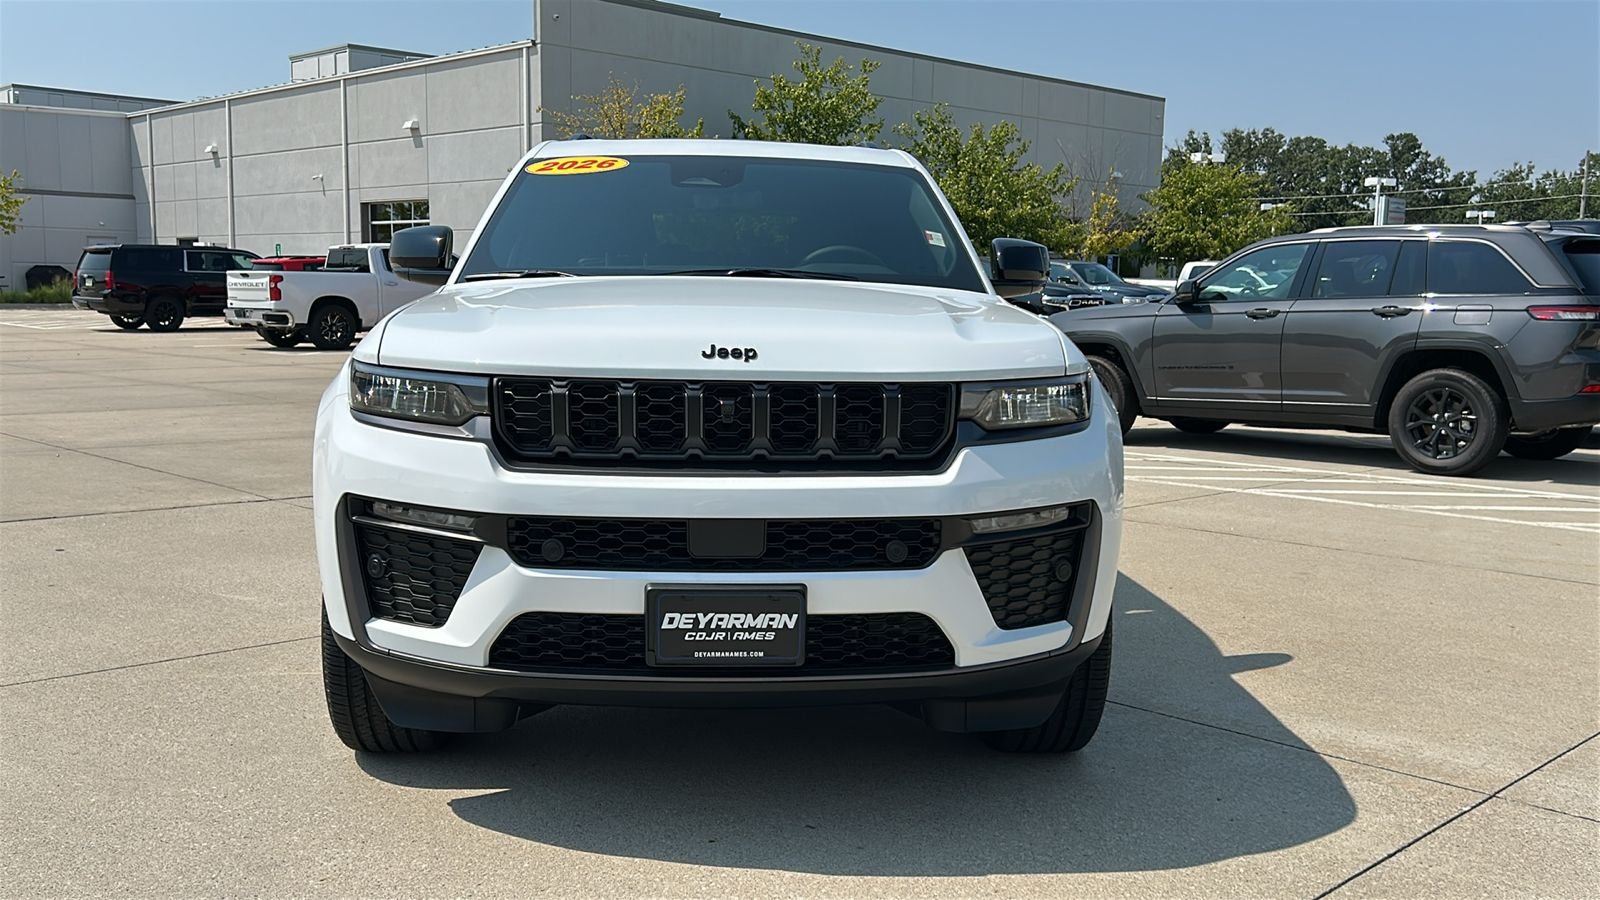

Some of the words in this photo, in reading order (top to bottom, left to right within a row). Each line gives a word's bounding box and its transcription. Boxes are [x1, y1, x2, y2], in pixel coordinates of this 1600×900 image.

[535, 160, 619, 172] 2026
[701, 344, 758, 363] Jeep
[661, 613, 799, 629] DEYARMAN
[685, 632, 726, 640] CDJR
[732, 632, 776, 640] AMES
